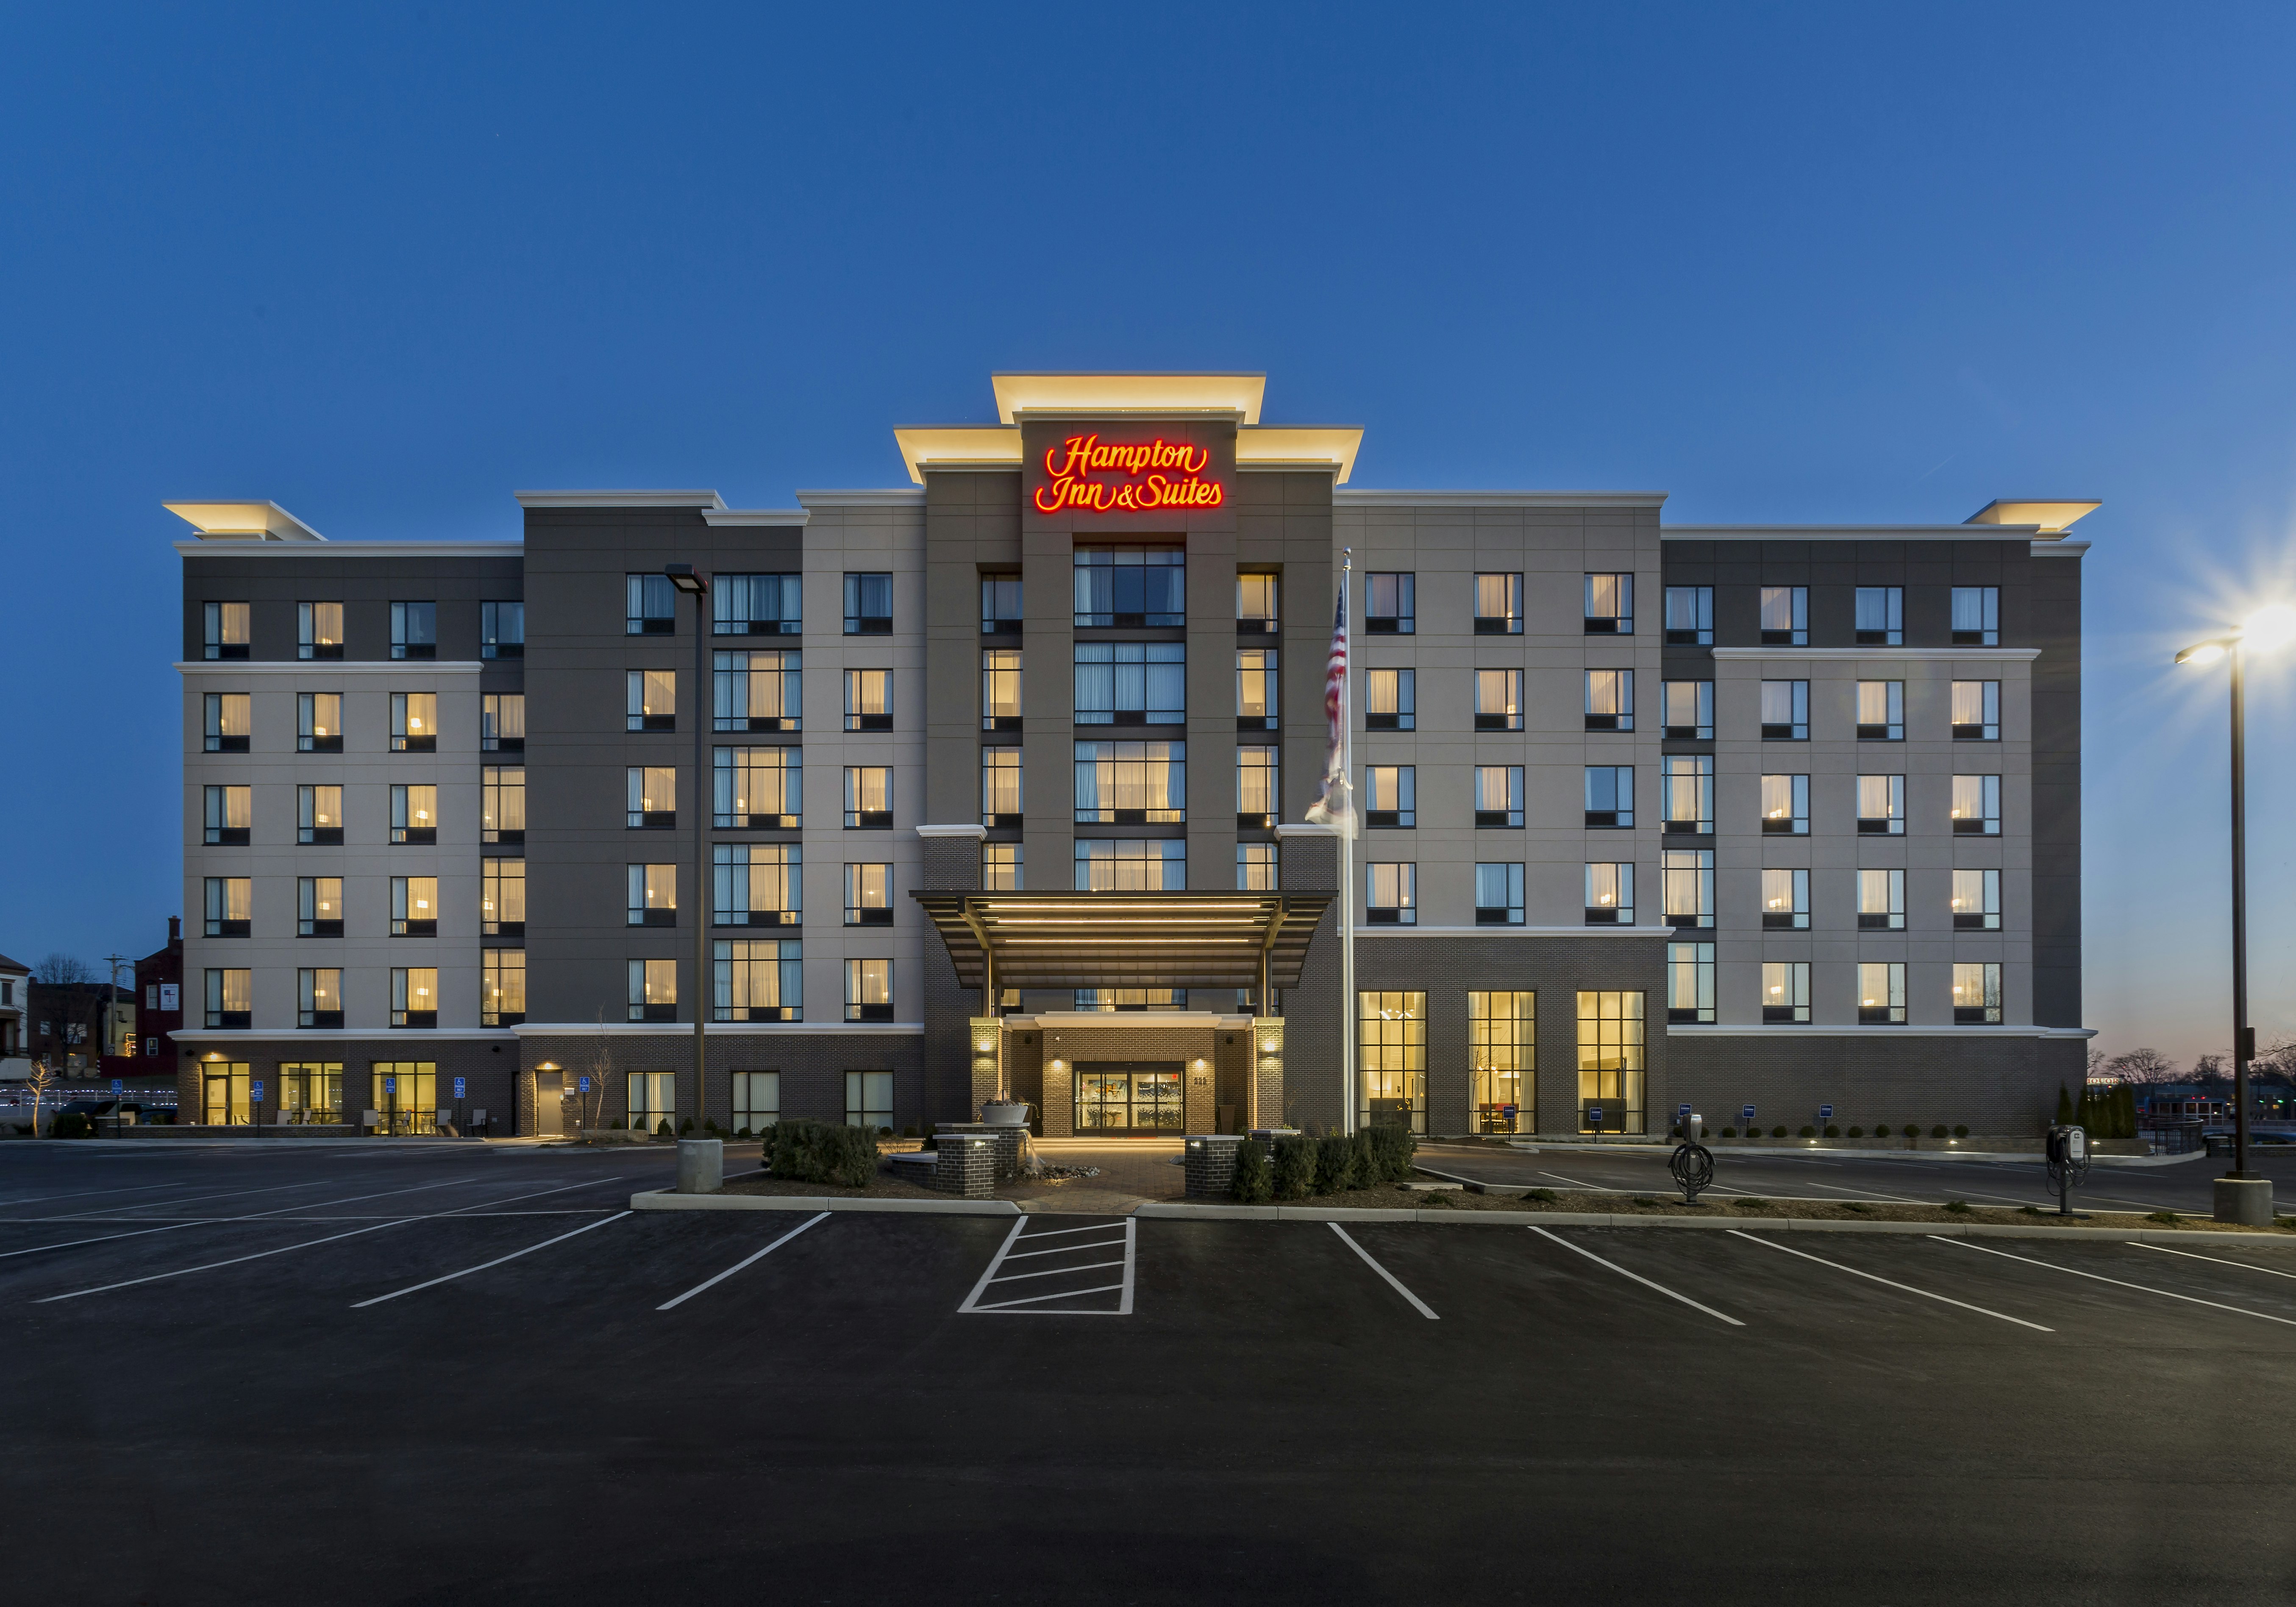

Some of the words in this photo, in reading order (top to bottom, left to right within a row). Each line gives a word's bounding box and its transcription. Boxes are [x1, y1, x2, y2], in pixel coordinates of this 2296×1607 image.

[1046, 434, 1207, 477] Hampton
[1036, 476, 1117, 510] Inn
[1117, 484, 1138, 509] &
[1136, 475, 1222, 507] Suites
